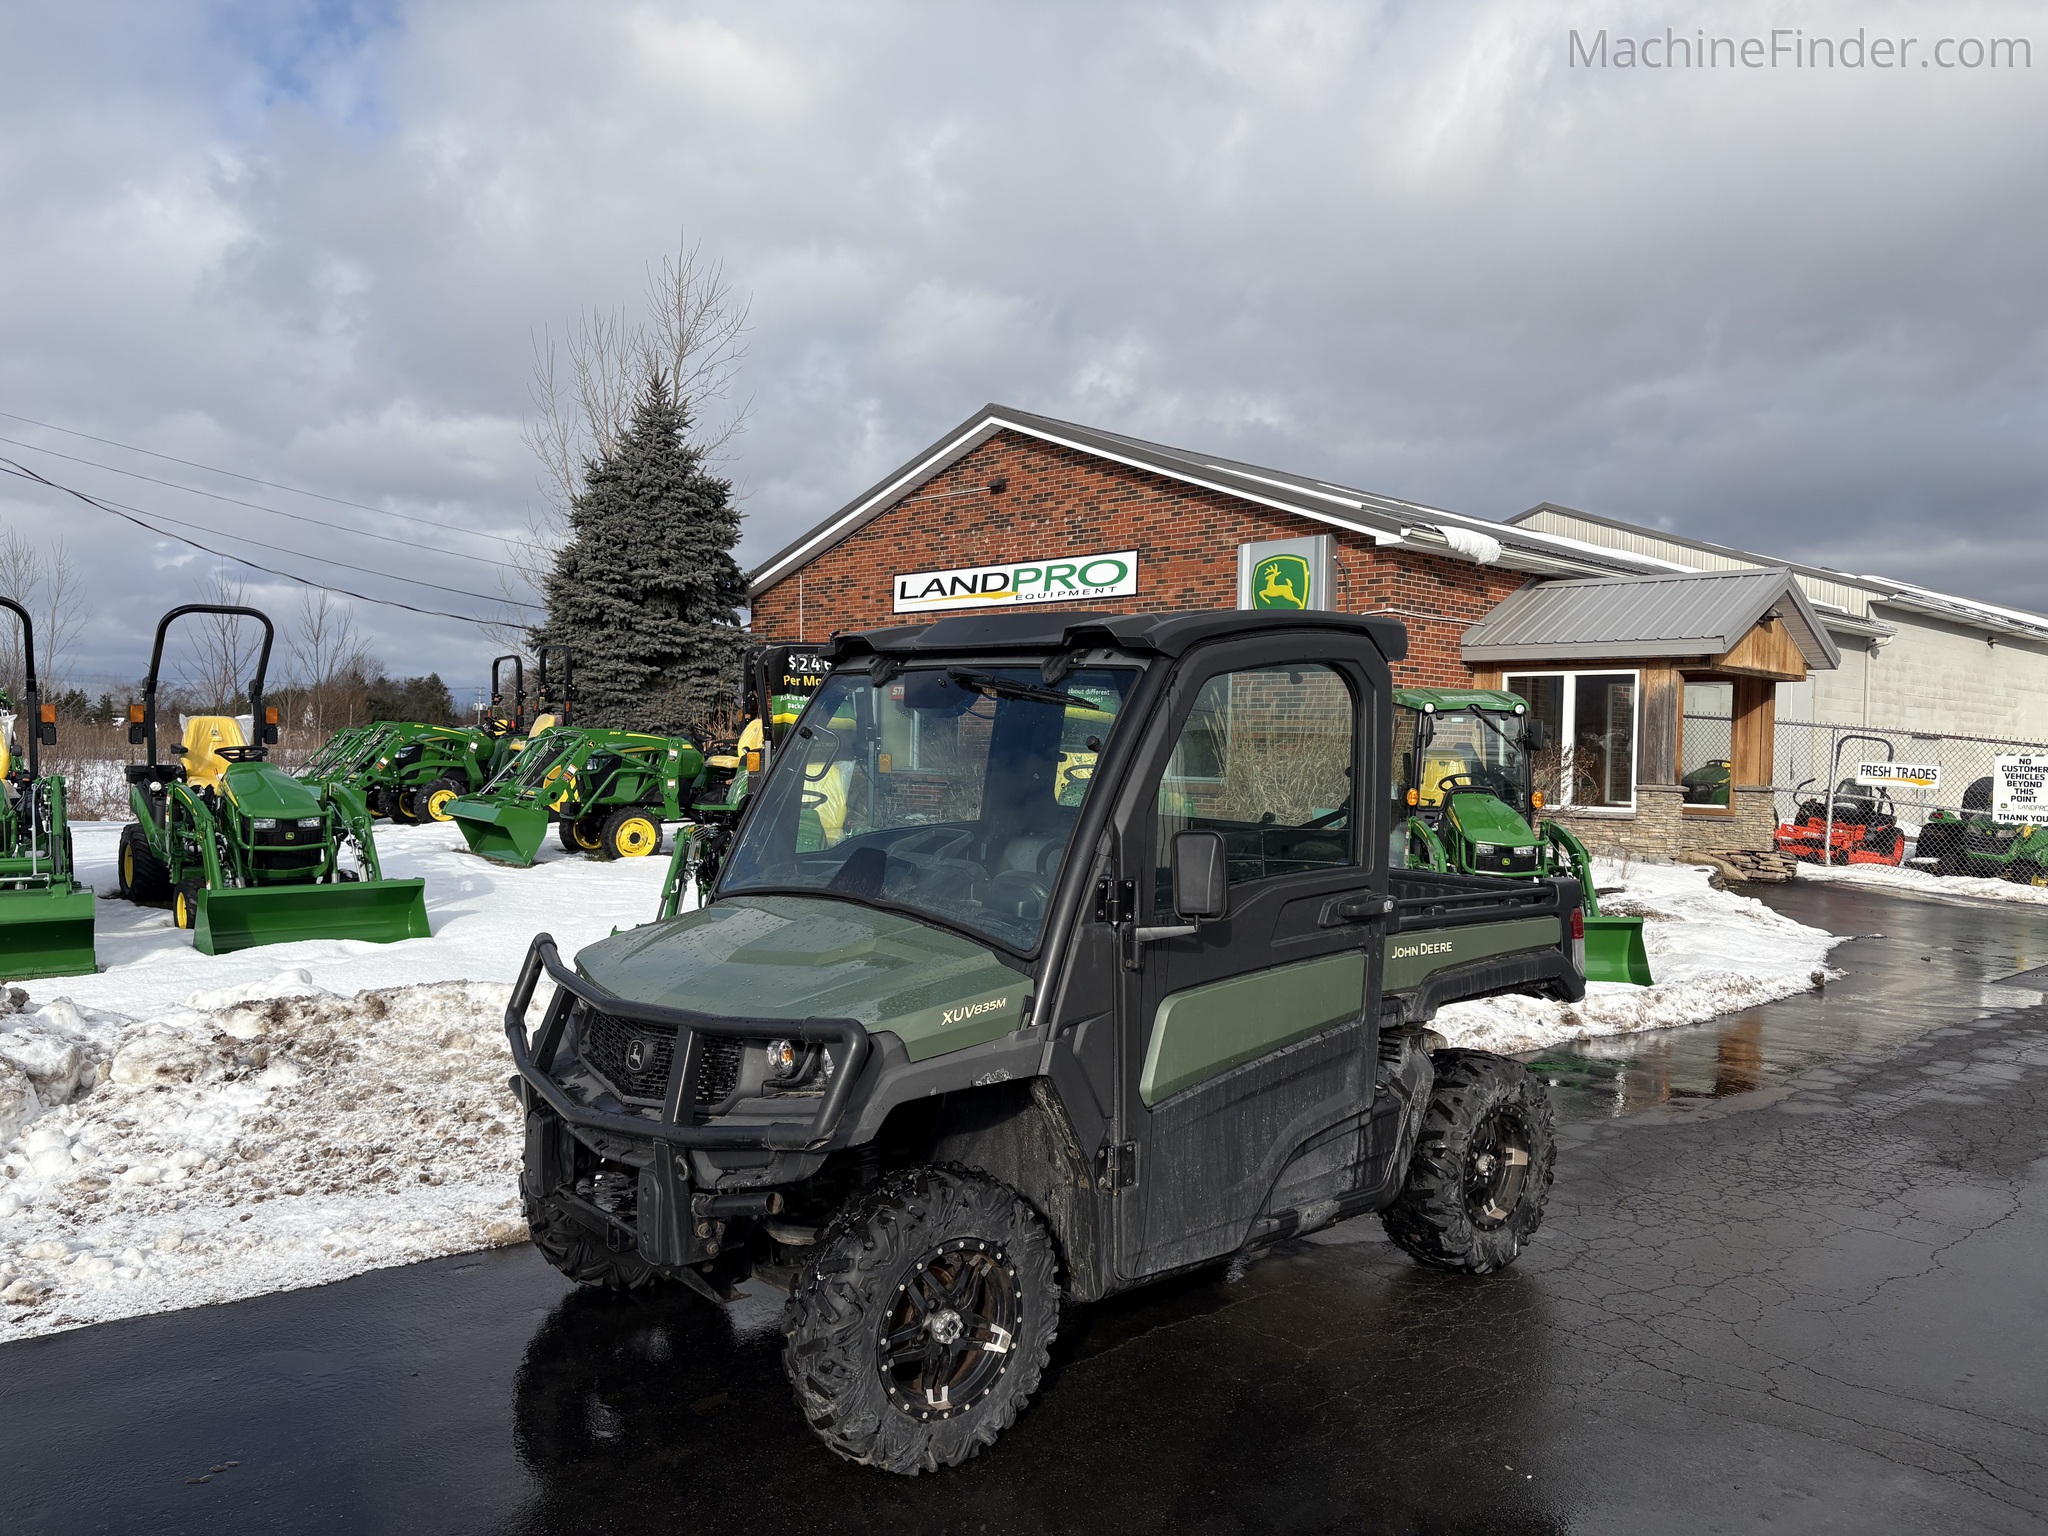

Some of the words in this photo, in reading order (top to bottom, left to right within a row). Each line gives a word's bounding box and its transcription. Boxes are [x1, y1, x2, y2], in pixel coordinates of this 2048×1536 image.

[899, 559, 1129, 600] LANDPRO
[1015, 586, 1118, 601] EQUIPMENT
[783, 674, 801, 687] Per
[1067, 687, 1085, 695] about
[1085, 688, 1110, 696] different
[780, 693, 791, 702] Ask
[1860, 764, 1892, 777] FRESH
[1896, 766, 1937, 780] TRADES
[2001, 765, 2048, 773] CUSTOMER
[2004, 772, 2045, 781] VEHICLES
[2006, 780, 2042, 788] BEYOND
[2014, 787, 2034, 796] THIS
[2010, 795, 2037, 803] POINT
[1998, 813, 2028, 821] THANK
[2030, 814, 2048, 822] YOU
[1391, 945, 1419, 959] JOHN
[1420, 941, 1453, 955] DEERE
[940, 997, 1007, 1026] XUV835M
